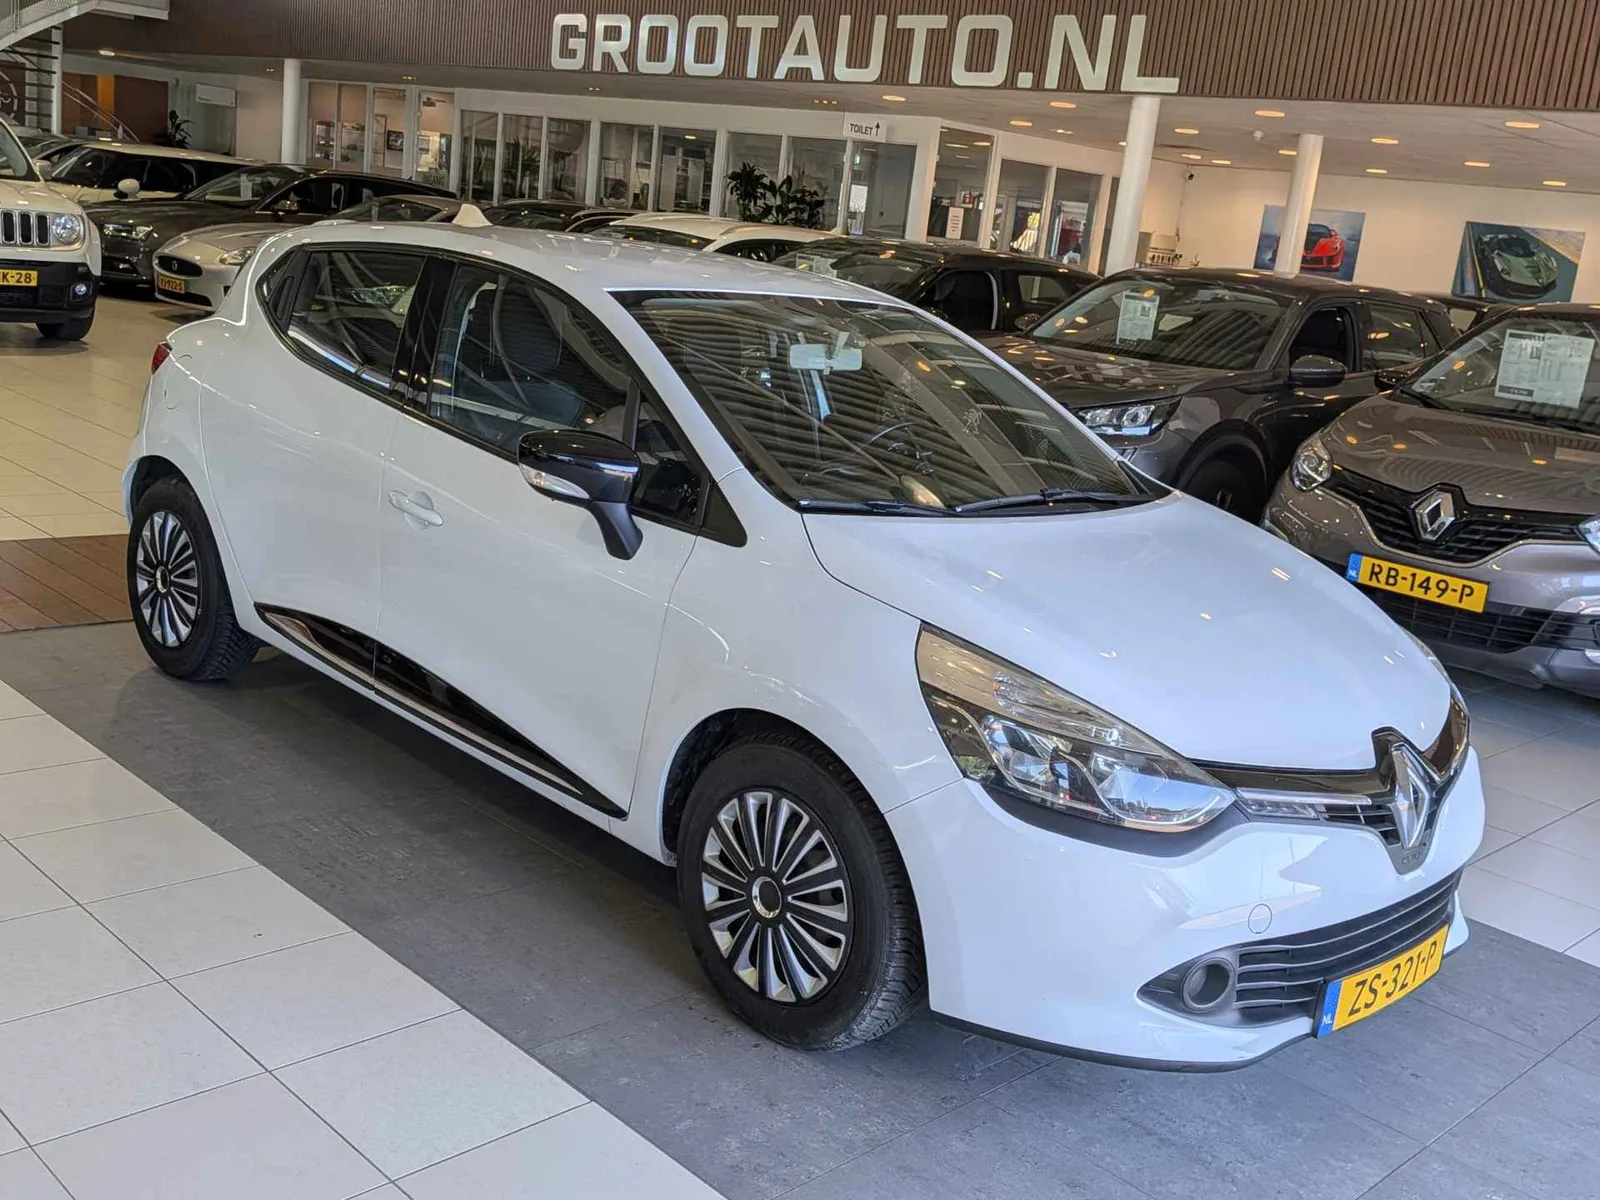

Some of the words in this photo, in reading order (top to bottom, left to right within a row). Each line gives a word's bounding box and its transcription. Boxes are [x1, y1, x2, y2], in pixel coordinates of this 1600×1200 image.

[551, 13, 1179, 93] GROOTAUTO.NL
[850, 122, 874, 136] TOILET
[1349, 569, 1358, 578] NL
[1368, 562, 1475, 604] RB-149-P
[1321, 1012, 1333, 1027] NL
[1347, 939, 1438, 1018] ZS-321-P
